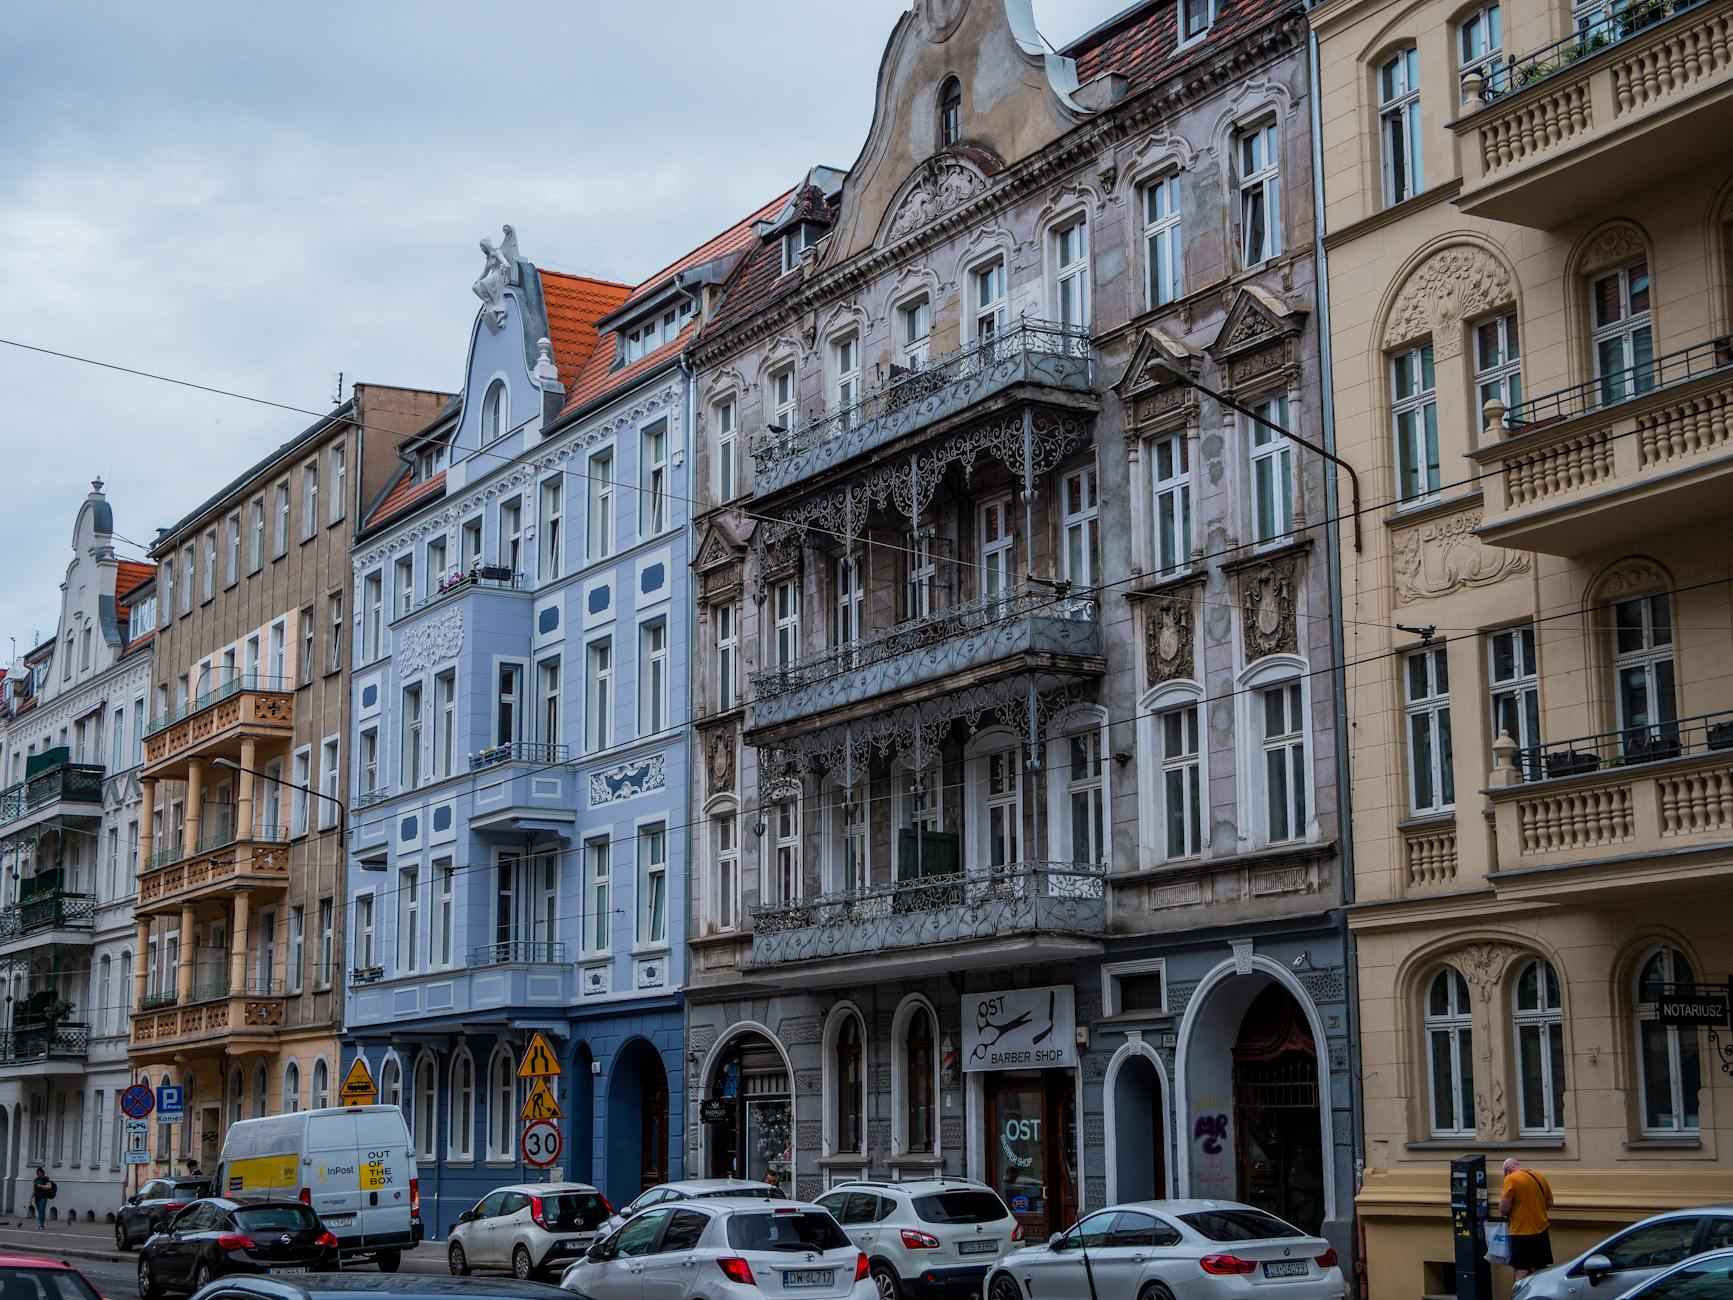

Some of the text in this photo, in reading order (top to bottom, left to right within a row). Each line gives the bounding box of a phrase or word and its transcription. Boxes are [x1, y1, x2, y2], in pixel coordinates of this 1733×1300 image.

[978, 996, 1006, 1018] OST
[1663, 1003, 1723, 1017] NOTARIUSZ
[991, 1048, 1063, 1065] BARBER SHOP
[162, 1088, 178, 1109] P
[1006, 1119, 1041, 1141] OST
[527, 1132, 557, 1156] 30
[367, 1150, 391, 1159] OUT
[327, 1165, 355, 1176] InPost
[368, 1160, 385, 1168] OF
[369, 1167, 393, 1177] THE
[1475, 1170, 1484, 1183] P
[370, 1176, 393, 1186] BOX
